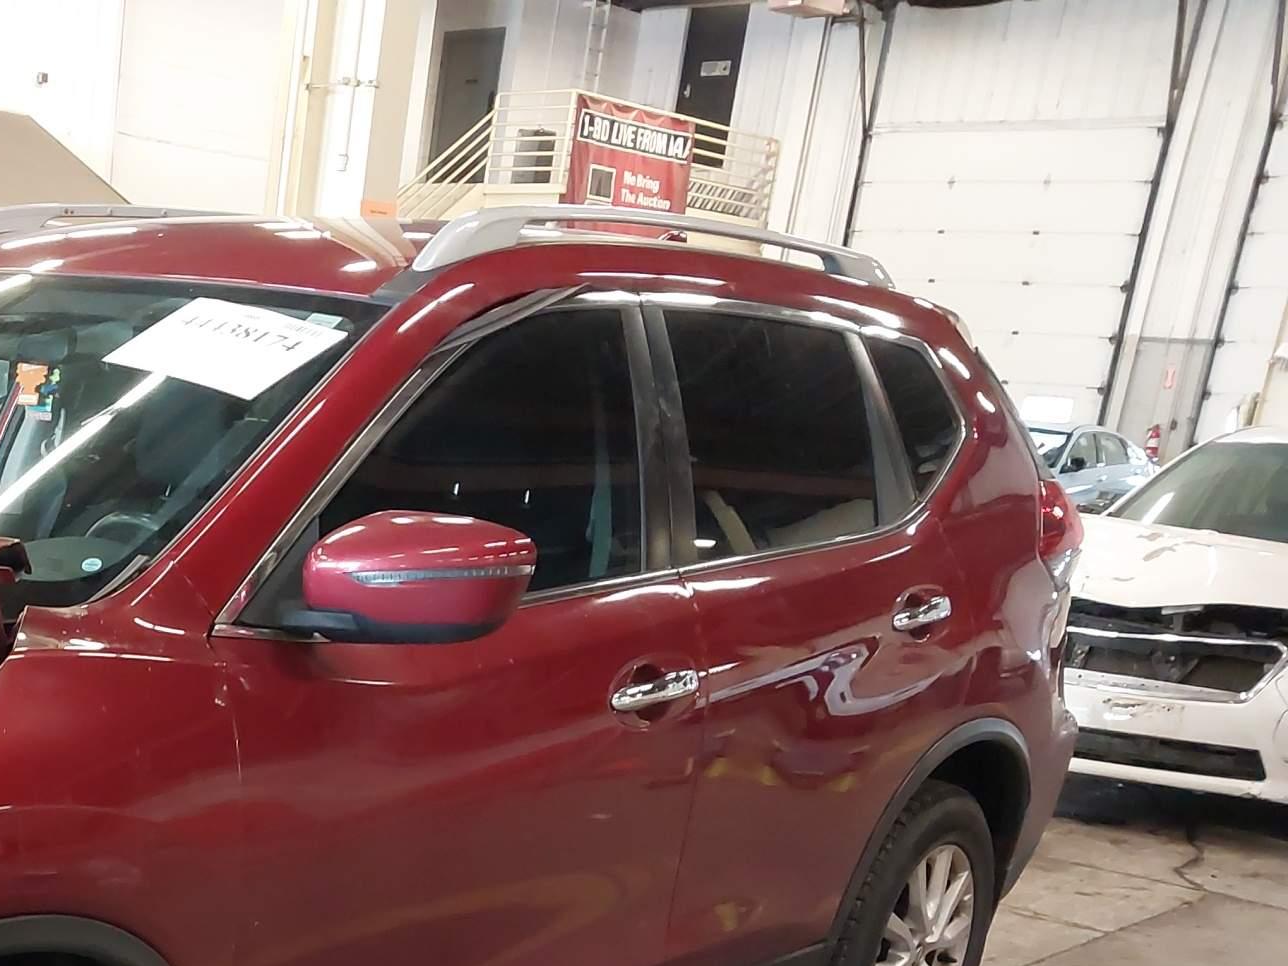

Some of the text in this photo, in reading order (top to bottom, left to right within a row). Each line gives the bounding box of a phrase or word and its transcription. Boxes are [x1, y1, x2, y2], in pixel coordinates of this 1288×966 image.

[611, 122, 637, 148] LIVE
[636, 128, 668, 155] FROM
[637, 174, 660, 194] Bring
[621, 188, 671, 210] The Auction
